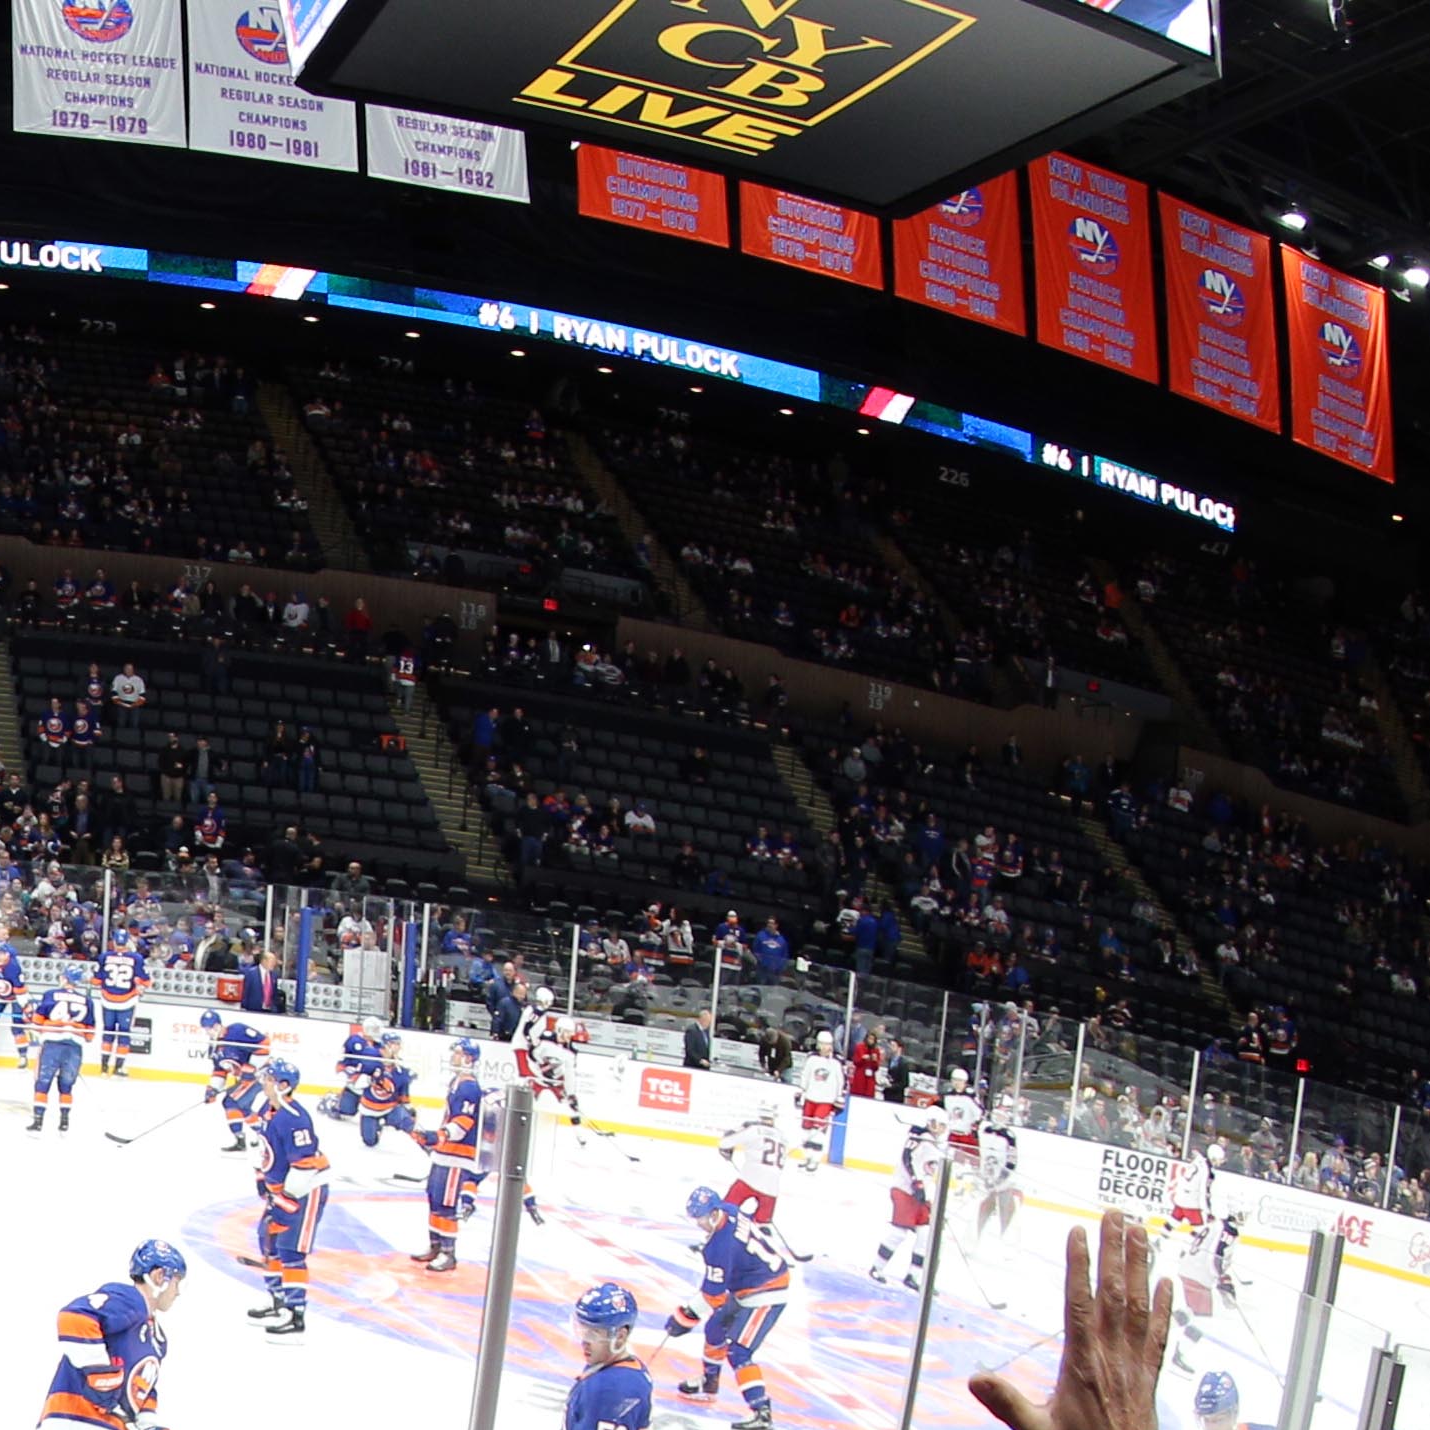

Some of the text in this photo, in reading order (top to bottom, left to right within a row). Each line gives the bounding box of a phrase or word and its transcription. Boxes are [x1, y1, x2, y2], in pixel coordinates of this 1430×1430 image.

[20, 43, 177, 70] NATIONAL HOCKEY LEAGUE
[46, 68, 152, 89] REGULAR SEASON
[194, 61, 251, 82] NATIONAL
[64, 91, 135, 108] CHAMPIONS
[221, 88, 325, 113] REGULAR SEASON
[519, 69, 802, 150] LIVE
[238, 111, 308, 132] CHAMPIONS
[397, 115, 496, 142] REGULAR SEASON
[415, 140, 481, 162] CHAMPIONS
[617, 156, 687, 189] DIVISION
[1048, 155, 1127, 202] NEW YORK
[607, 176, 699, 212] CHAMPIONS
[1049, 178, 1130, 224] ISLANDERS
[777, 197, 843, 230] DIVISION
[767, 216, 855, 254] CHAMPIONS
[919, 260, 1000, 301] CHAMPIONS
[479, 302, 740, 378] #6 RYAN PULOCK
[939, 466, 970, 487] 226
[1042, 442, 1157, 500] #6 RYAN
[184, 566, 211, 578] 117
[103, 964, 133, 988] 32
[645, 1077, 685, 1104] TCL
[293, 1130, 312, 1146] 21
[1101, 1149, 1169, 1178] FLOOR
[707, 1266, 724, 1282] 12
